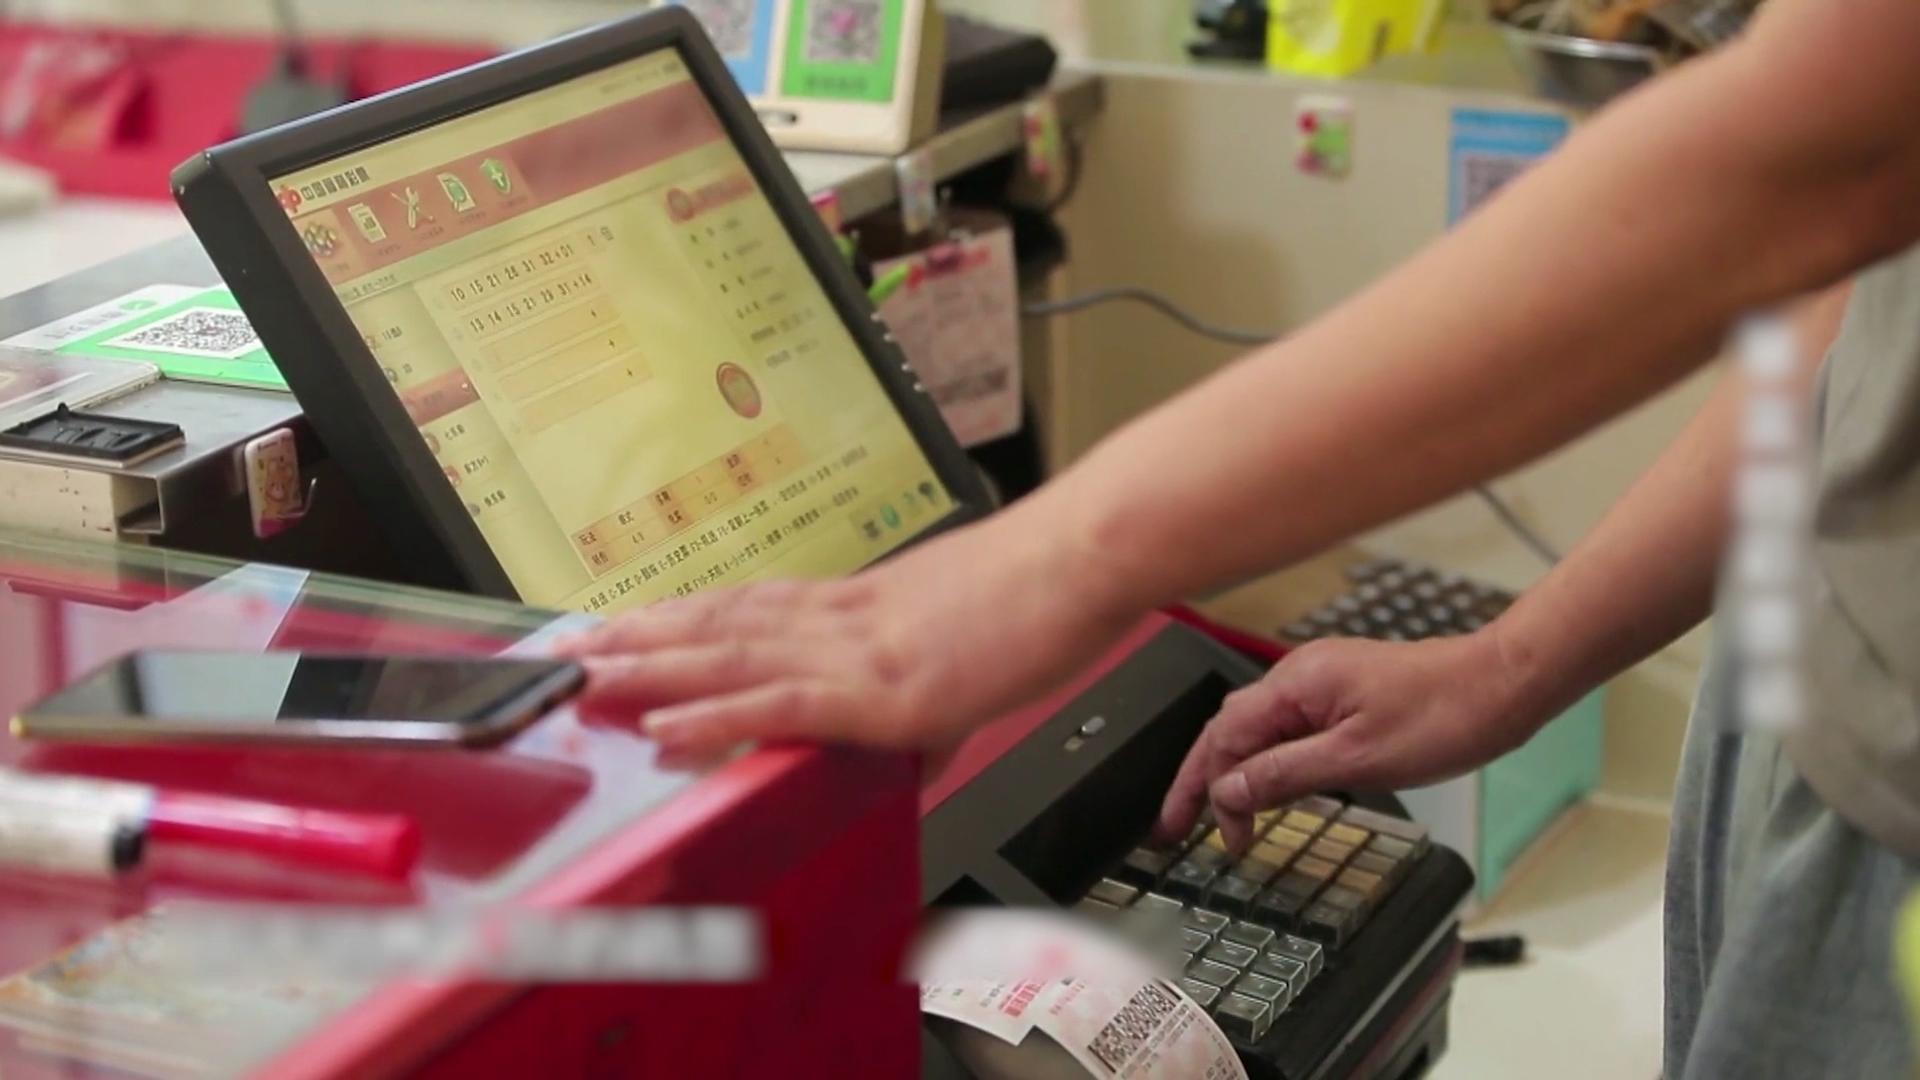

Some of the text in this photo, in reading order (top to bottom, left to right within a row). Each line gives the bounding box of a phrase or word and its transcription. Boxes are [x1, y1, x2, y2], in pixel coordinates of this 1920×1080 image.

[451, 288, 465, 301] 10
[470, 280, 483, 294] 15
[486, 274, 501, 287] 21
[522, 260, 536, 272] 31
[506, 303, 520, 317] 15
[523, 297, 536, 310] 21
